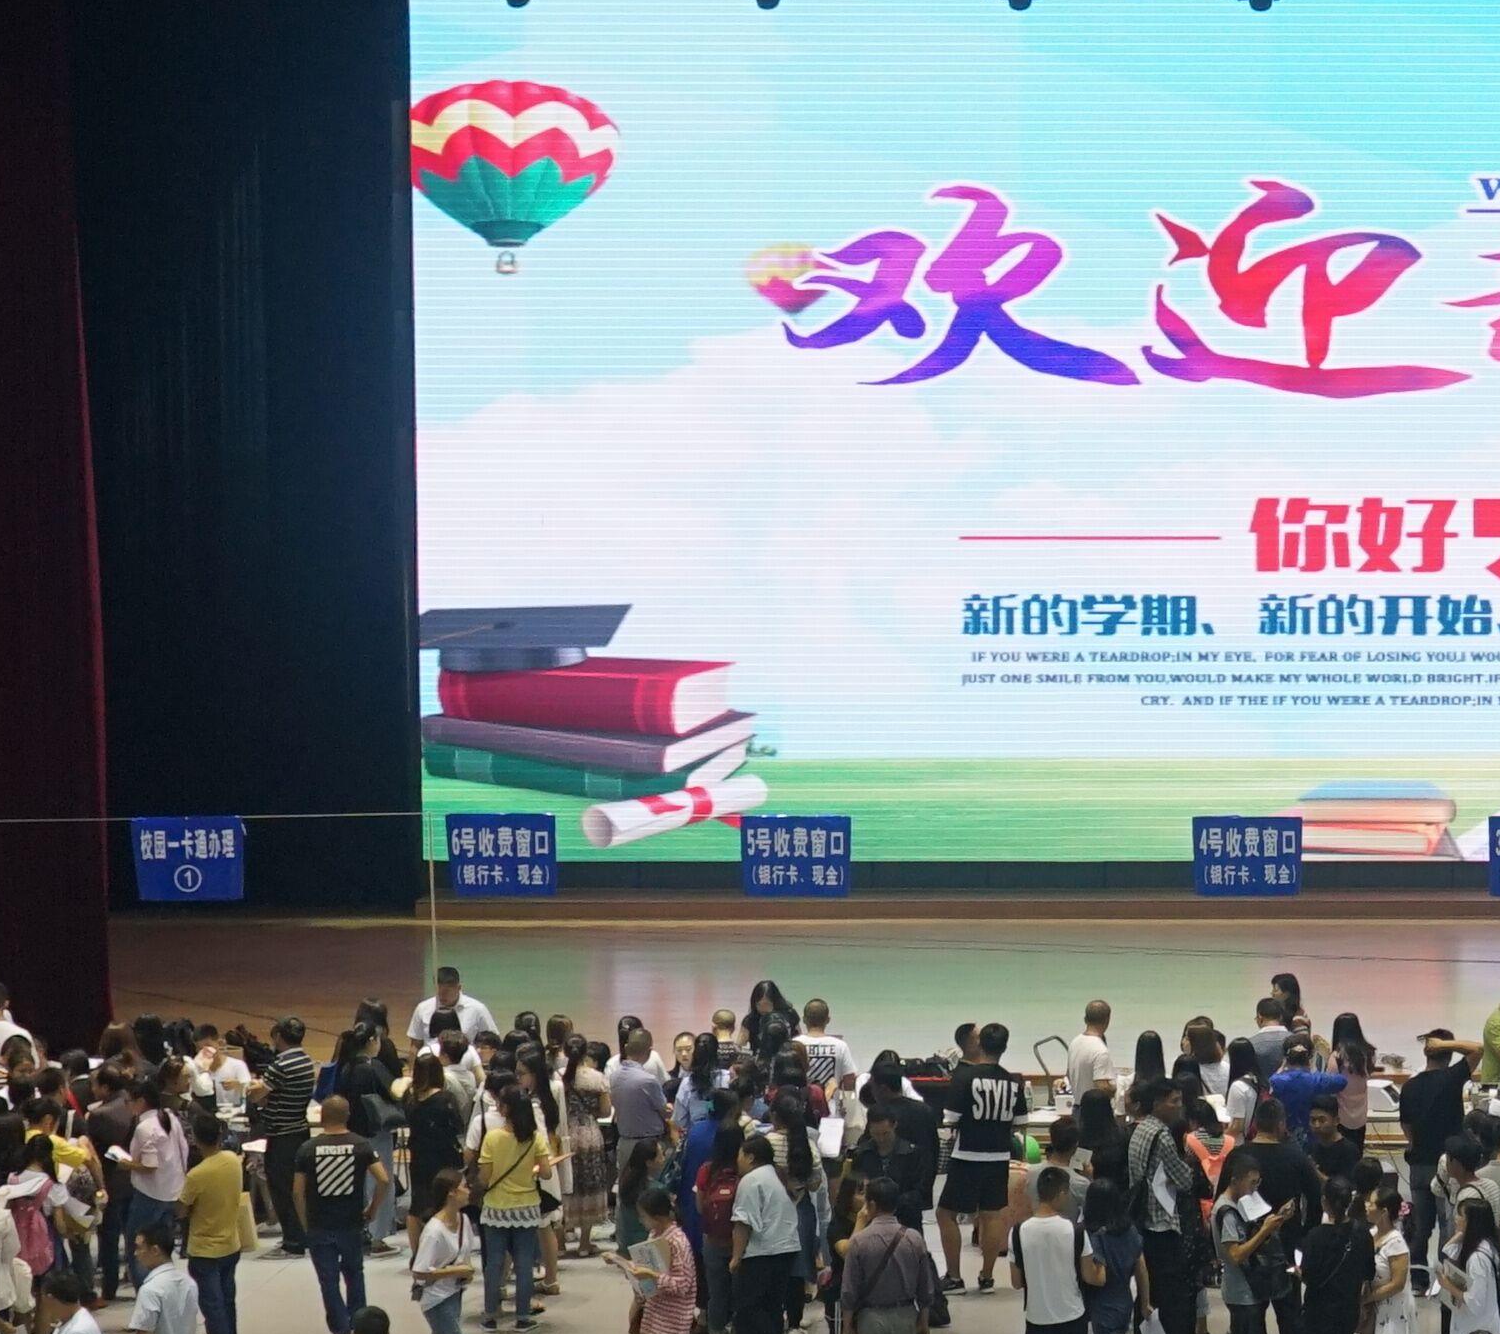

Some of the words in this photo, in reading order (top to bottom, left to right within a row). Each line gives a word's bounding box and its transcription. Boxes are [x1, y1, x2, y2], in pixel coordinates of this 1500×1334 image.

[971, 651, 986, 663] IF
[991, 651, 1020, 663] YOU
[1026, 651, 1069, 663] WERE
[1074, 651, 1085, 663] A
[1198, 651, 1219, 663] MY
[1265, 651, 1294, 663] FOR
[1300, 651, 1338, 663] FEAR
[1343, 651, 1361, 663] OF
[1367, 651, 1421, 663] LOSING
[962, 673, 995, 686] JUST
[1000, 673, 1032, 684] ONE
[1036, 673, 1082, 684] SMILE
[1087, 673, 1130, 684] FROM
[1231, 673, 1274, 684] MAKE
[1279, 673, 1301, 684] MY
[1306, 673, 1361, 684] WHOLE
[1366, 673, 1422, 684] WORLD
[1182, 695, 1214, 706] AND
[1220, 695, 1233, 706] IF
[1238, 695, 1268, 706] THE
[1273, 695, 1287, 706] IF
[1292, 695, 1321, 706] YOU
[1327, 695, 1371, 706] WERE
[1375, 695, 1385, 706] A
[139, 828, 236, 860] 校园一卡通办理
[451, 827, 550, 858] 6号收费窗口
[747, 827, 845, 858] 5号收费窗口
[1199, 827, 1297, 858] 4号收费窗口
[972, 1078, 1019, 1121] STYLE
